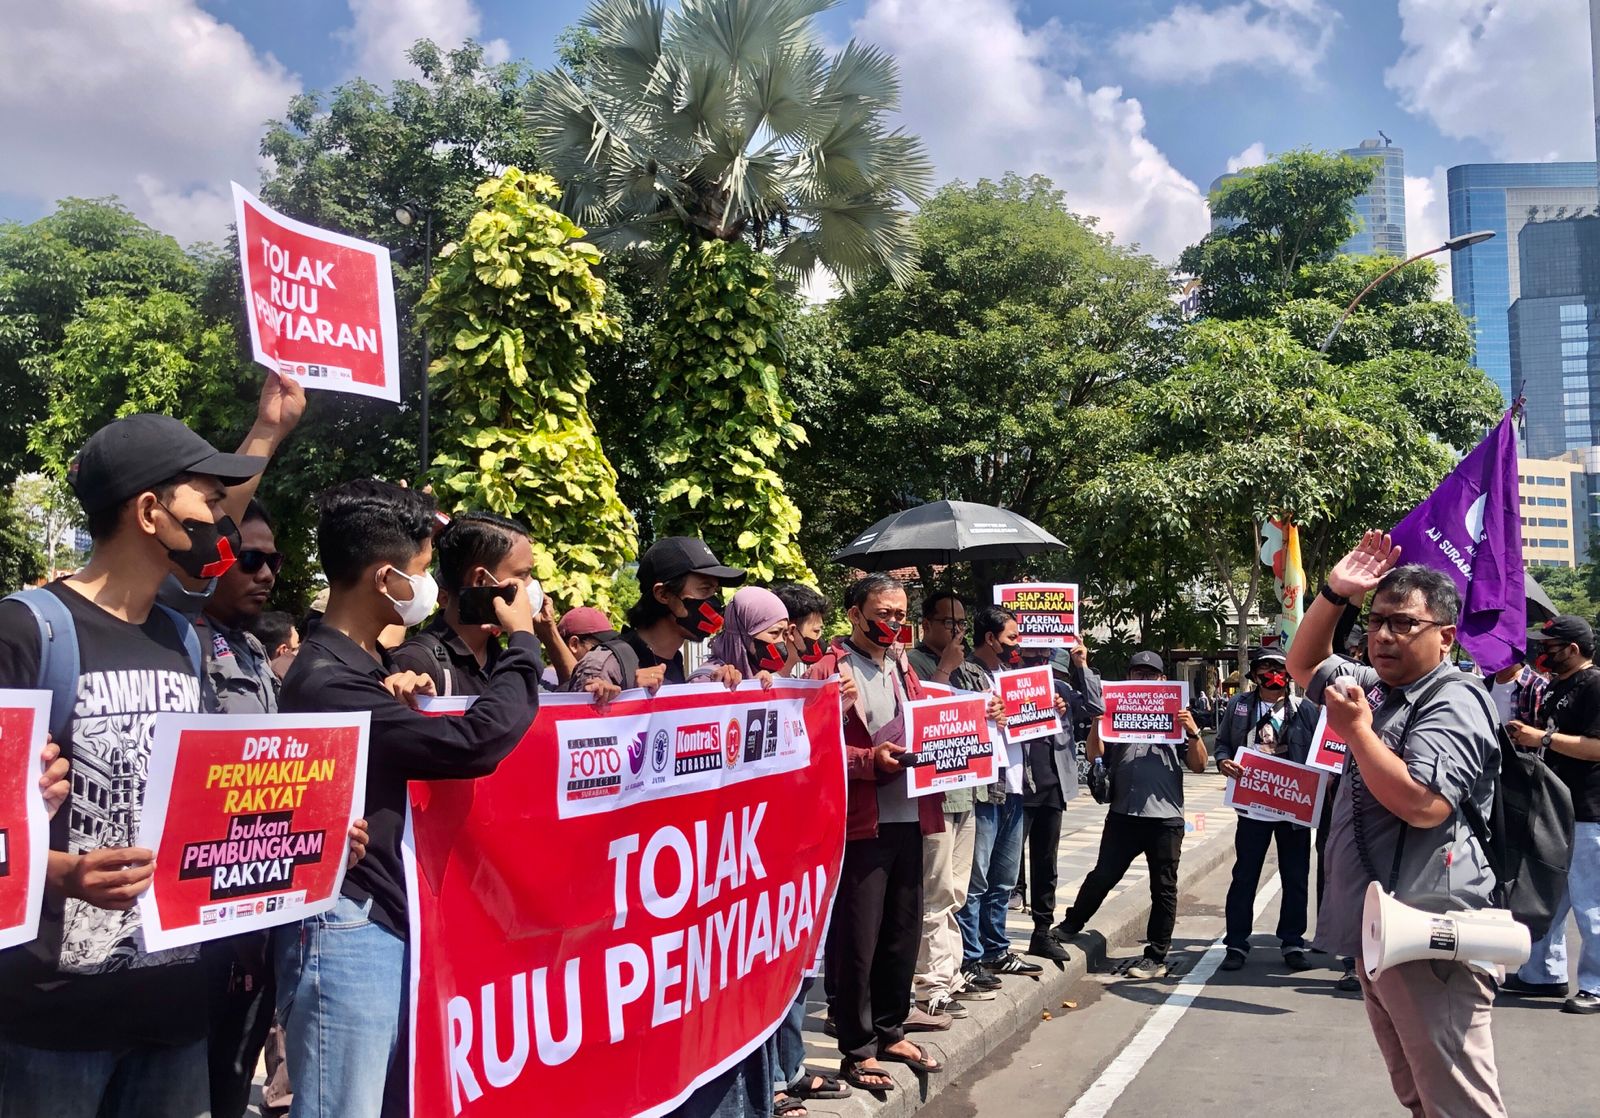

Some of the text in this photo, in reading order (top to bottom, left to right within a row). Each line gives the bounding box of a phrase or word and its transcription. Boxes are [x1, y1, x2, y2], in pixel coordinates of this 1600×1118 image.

[261, 237, 337, 290] TOLAK
[270, 274, 318, 314] RUU
[254, 291, 378, 354] PENYIARAN
[1425, 526, 1443, 542] AJI
[1017, 592, 1065, 602] SIAP-SIAP
[1003, 601, 1074, 611] DIPENJARAKAN
[1023, 615, 1061, 624] KARENA
[1026, 624, 1074, 633] PENYIARAN
[1016, 677, 1032, 689] RUU
[1006, 685, 1047, 702] PENYIARAN
[1152, 692, 1178, 700] GAGAL
[939, 708, 959, 723] RUU
[1021, 702, 1036, 714] ALAT
[1116, 704, 1165, 712] MENGANCAM
[1113, 721, 1173, 730] BEREKSPRESI
[1115, 713, 1169, 722] KEBEBASAN
[922, 720, 976, 738] PENYIARAN
[677, 724, 720, 754] KontraS
[764, 738, 777, 753] LBH
[922, 735, 979, 752] MEMBUNGKAM
[242, 735, 309, 761] DPR itu
[937, 748, 955, 760] DAN
[955, 743, 992, 757] ASPIRASI
[570, 748, 621, 778] FOTO
[676, 752, 721, 774] SURABAYA
[935, 756, 967, 771] RAKYAT
[206, 759, 336, 789] PERWAKILAN
[223, 785, 308, 813] RAKYAT
[1240, 778, 1312, 807] BISA KENA
[230, 815, 290, 841] bukan
[183, 832, 324, 870] PEMBUNGKAM
[213, 858, 294, 890] RAKYAT
[607, 801, 768, 930] TOLAK
[447, 957, 582, 1116] RUU
